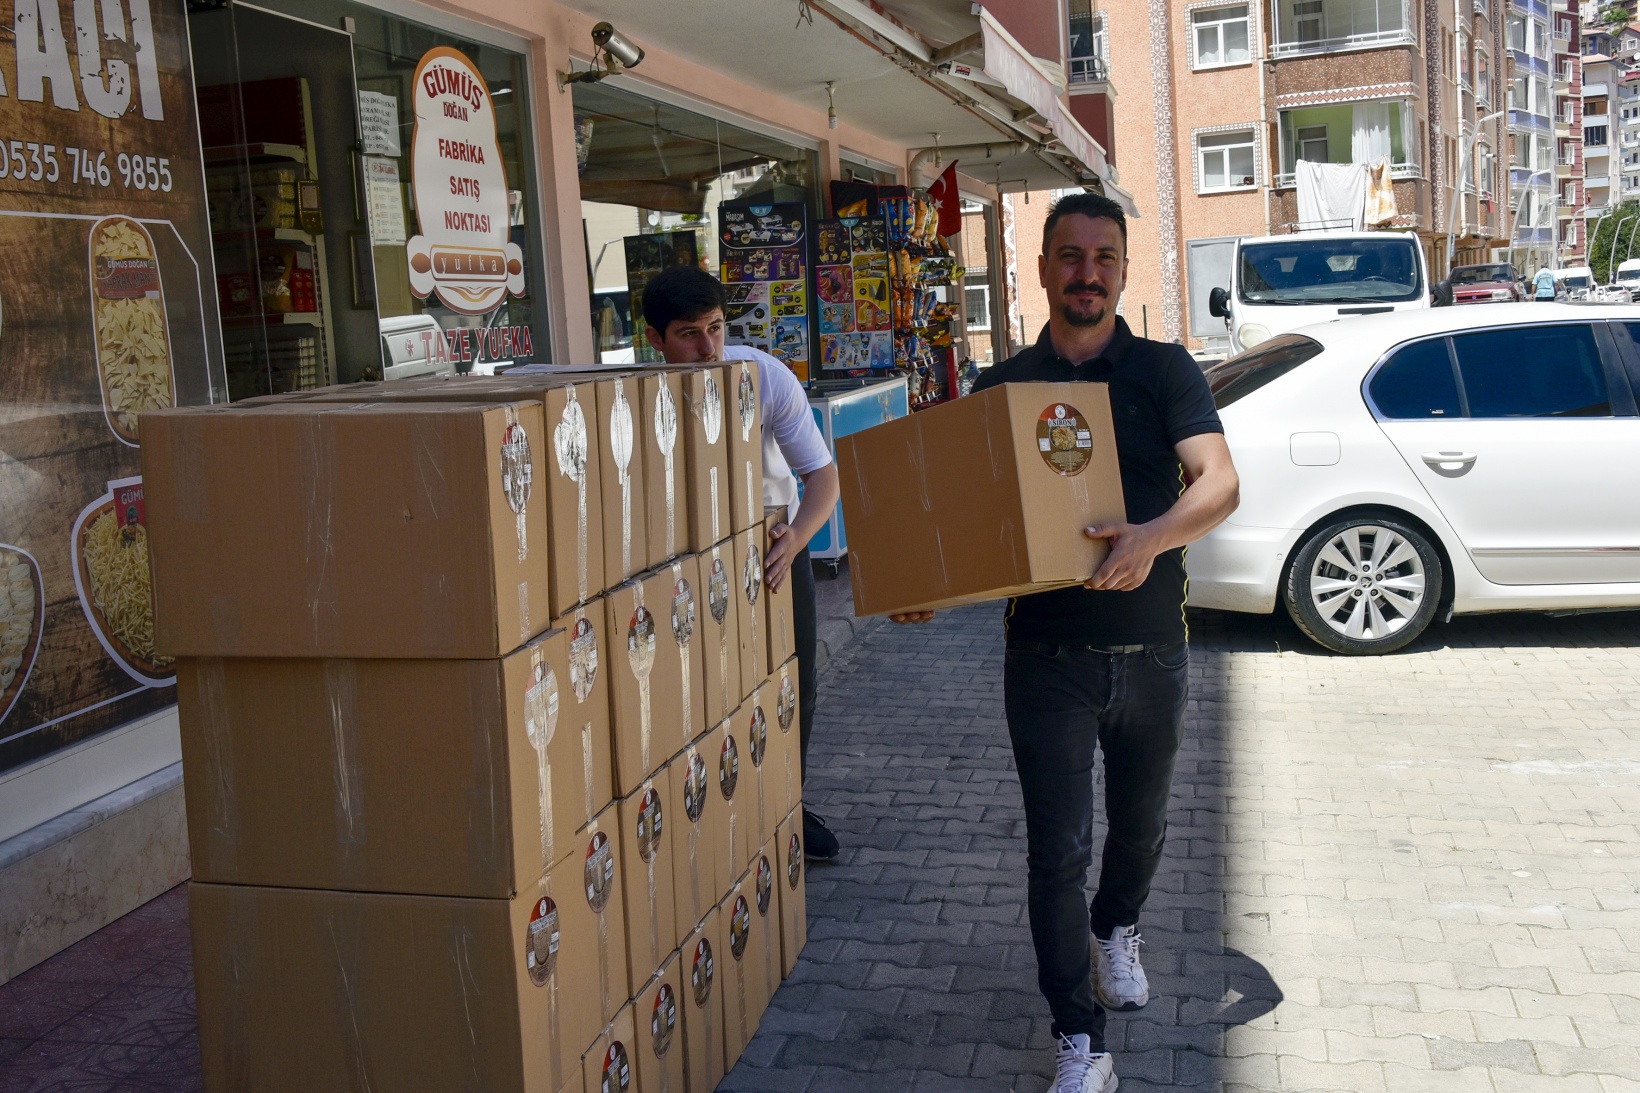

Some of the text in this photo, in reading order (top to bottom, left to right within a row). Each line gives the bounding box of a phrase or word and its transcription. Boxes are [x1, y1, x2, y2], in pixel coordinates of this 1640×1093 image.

[422, 64, 484, 113] GÜMÜŞ
[442, 101, 469, 122] DOĞAN
[438, 138, 485, 165] FABRİKA
[65, 147, 111, 187] 746
[117, 152, 173, 193] 9855
[449, 175, 480, 202] SATIŞ
[444, 210, 491, 233] NOKTASI
[421, 325, 534, 365] TAZE YUFKA
